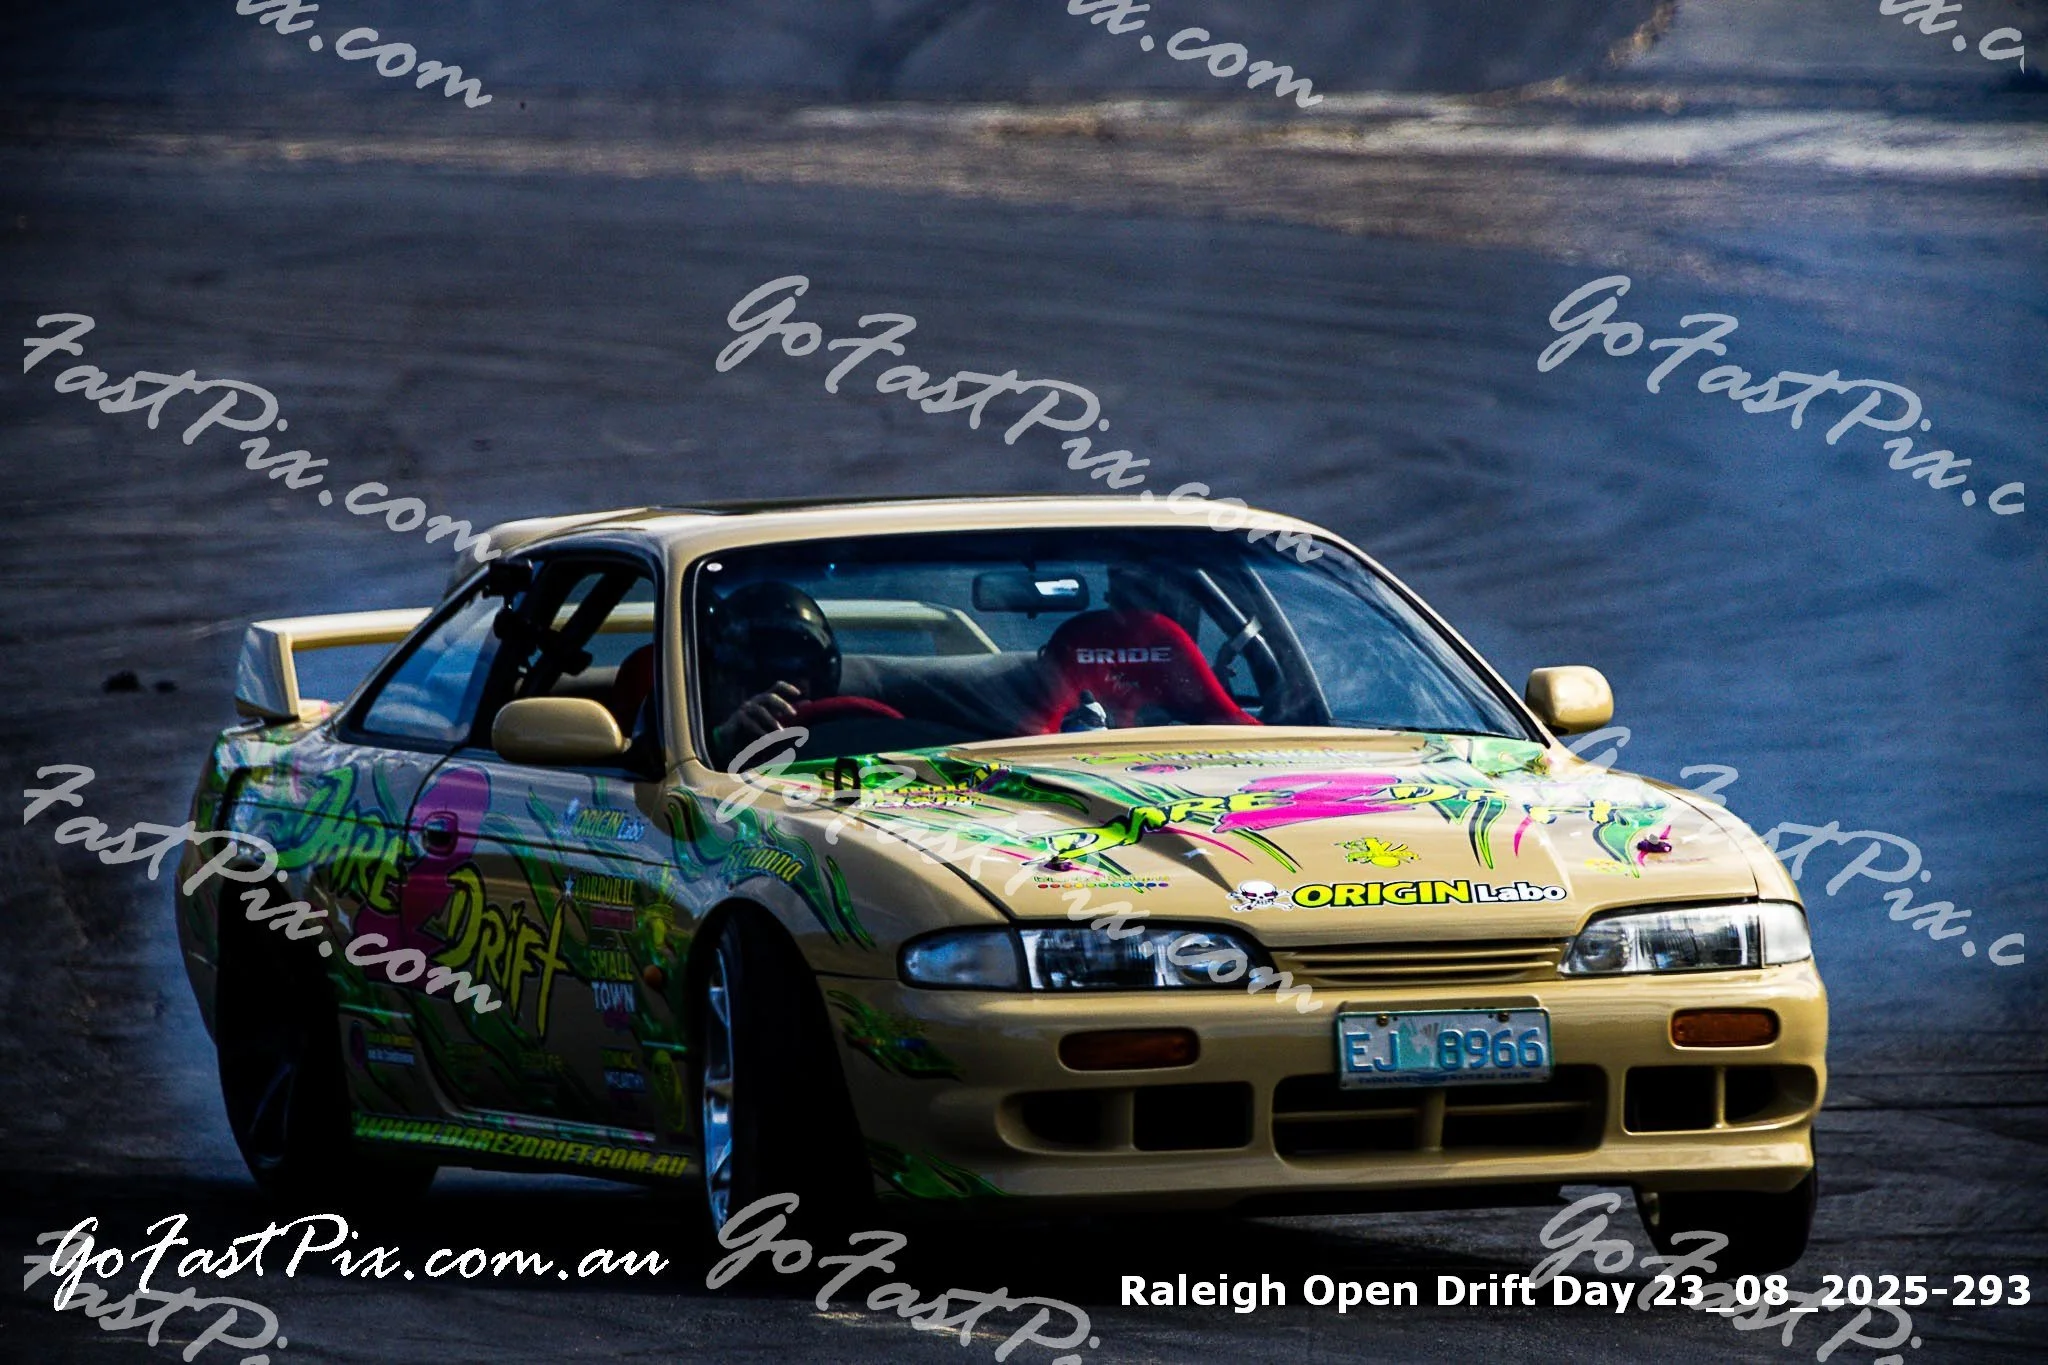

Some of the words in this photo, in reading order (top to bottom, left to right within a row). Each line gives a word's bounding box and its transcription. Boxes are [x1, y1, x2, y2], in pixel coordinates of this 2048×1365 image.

[1076, 645, 1172, 664] BRIDE
[1293, 882, 1471, 907] ORIGIN
[1473, 881, 1566, 902] Labo
[590, 948, 634, 981] SMALL
[591, 981, 636, 1013] TOWN
[1345, 1030, 1398, 1073] EJ
[1437, 1028, 1544, 1070] 8966
